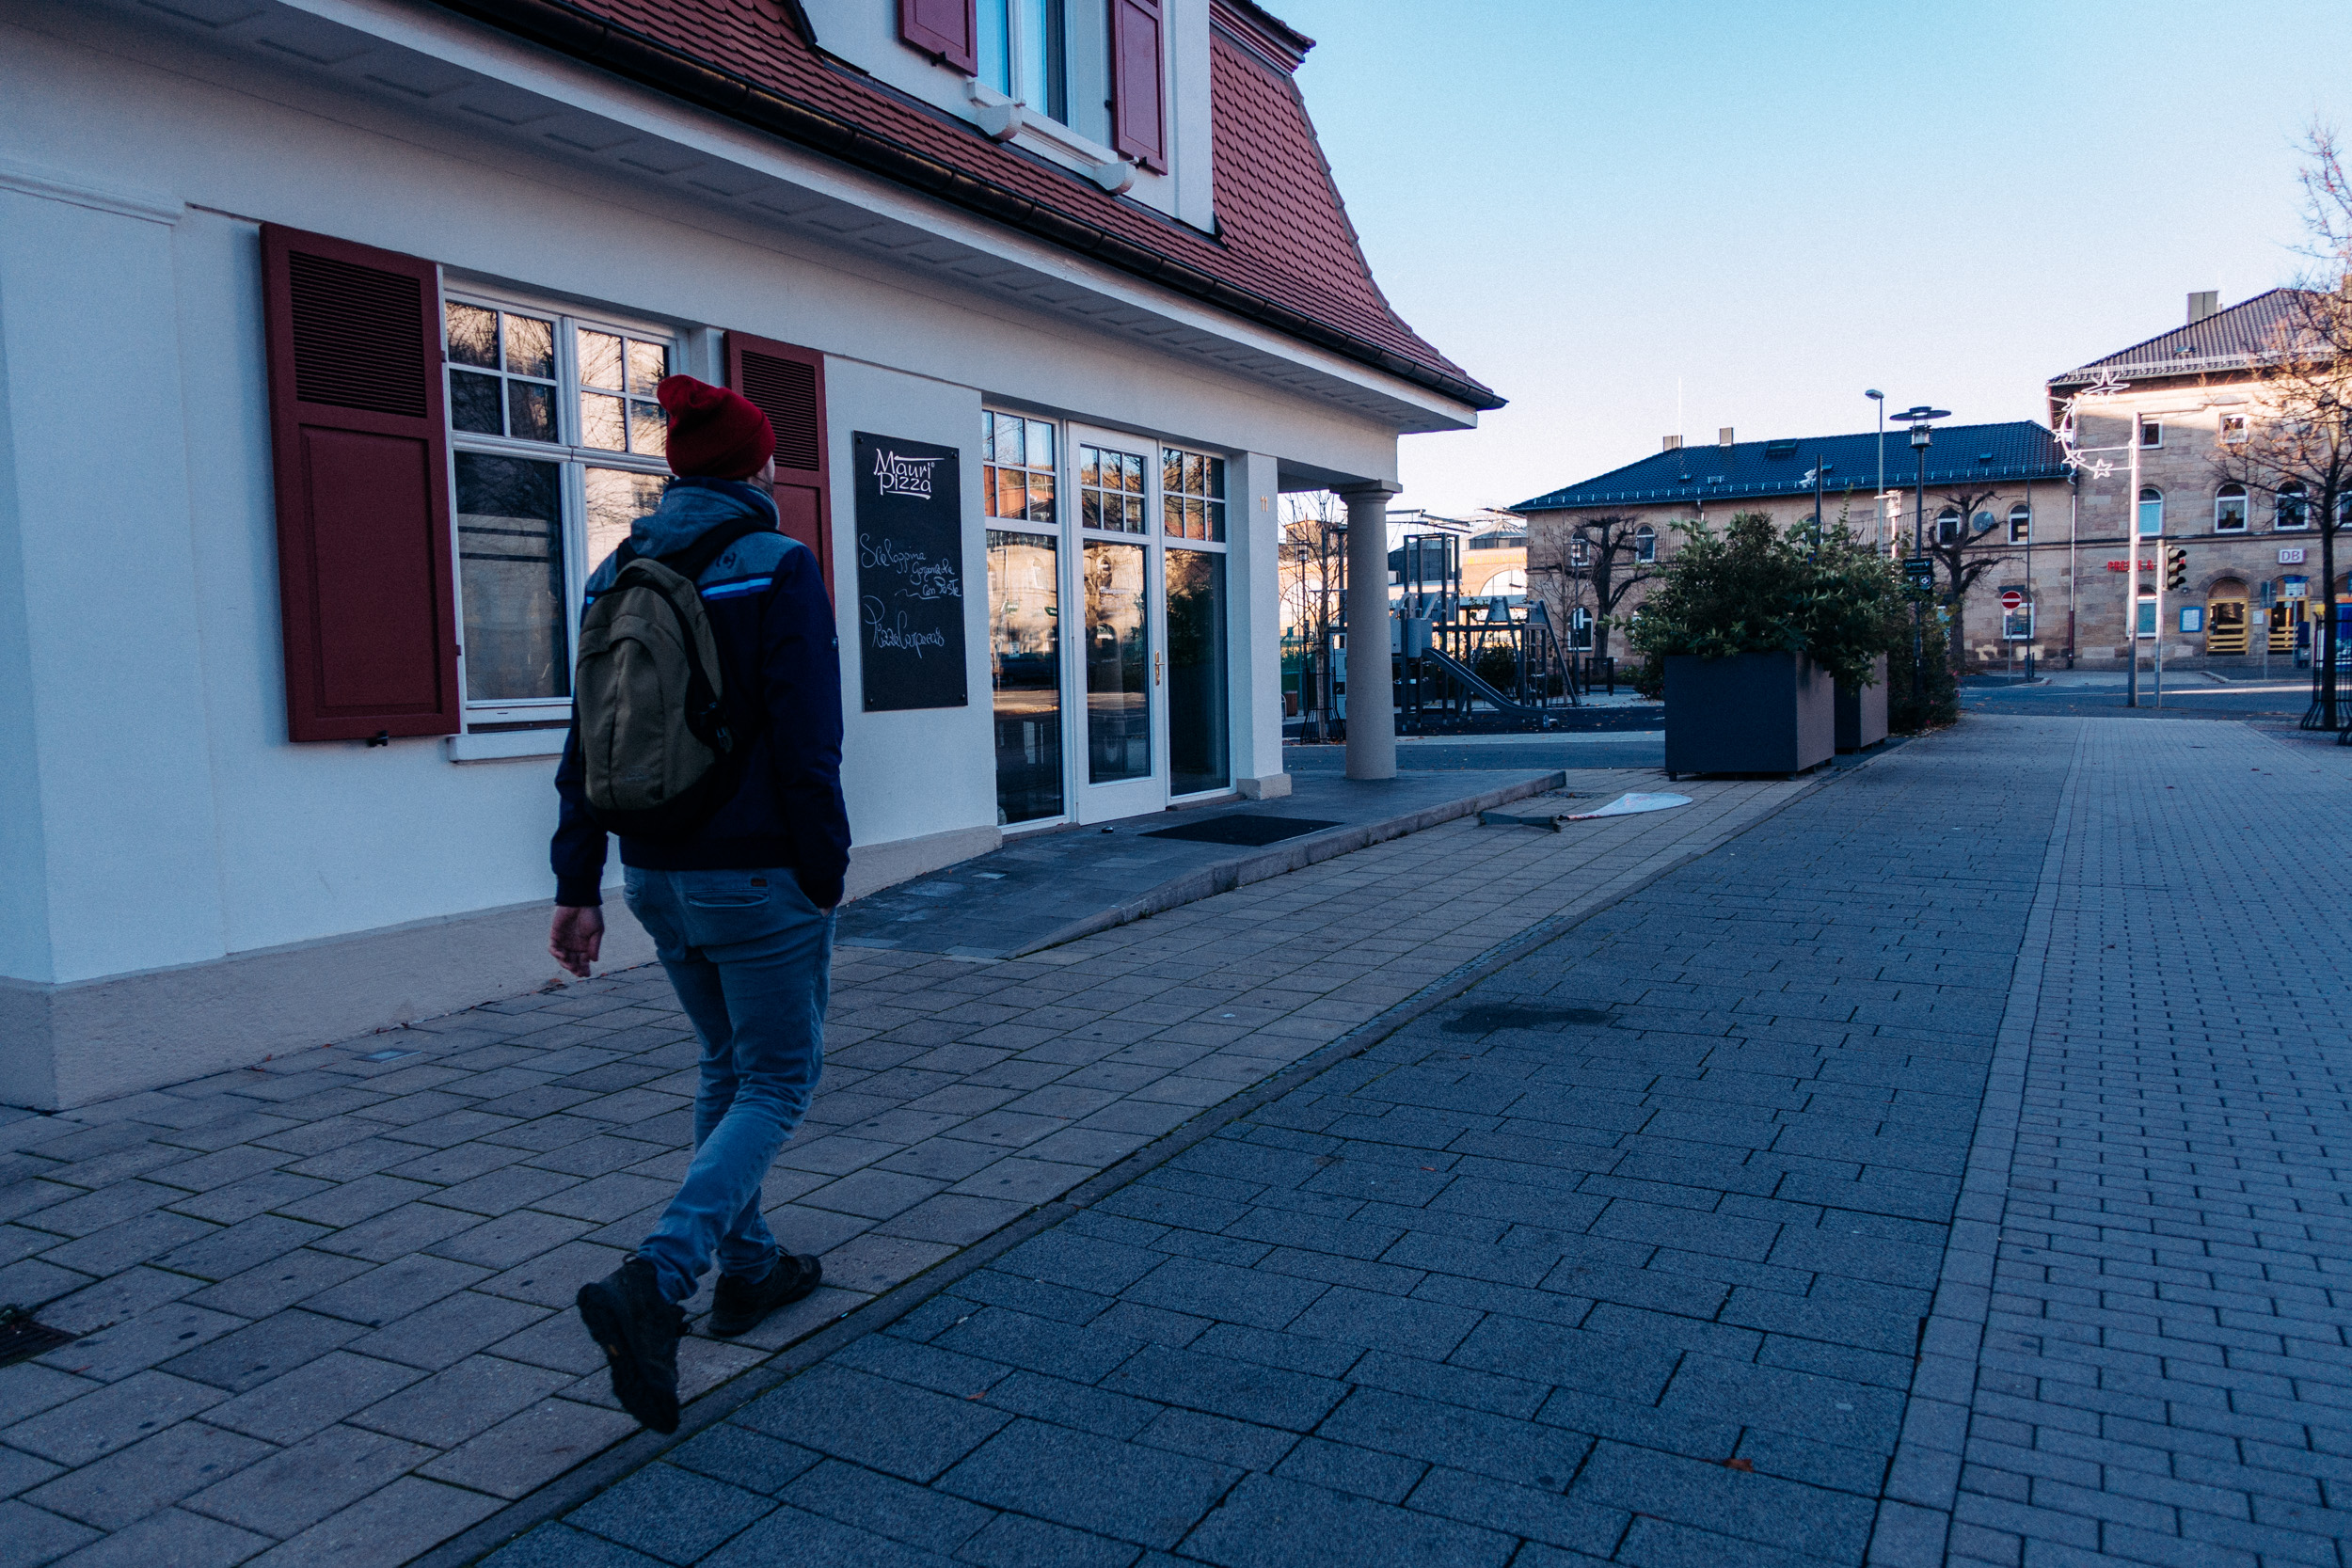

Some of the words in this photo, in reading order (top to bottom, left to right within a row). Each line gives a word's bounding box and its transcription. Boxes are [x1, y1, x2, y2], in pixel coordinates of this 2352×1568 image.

[877, 470, 932, 496] Pizza
[1260, 495, 1268, 513] 11
[2280, 550, 2301, 562] DB
